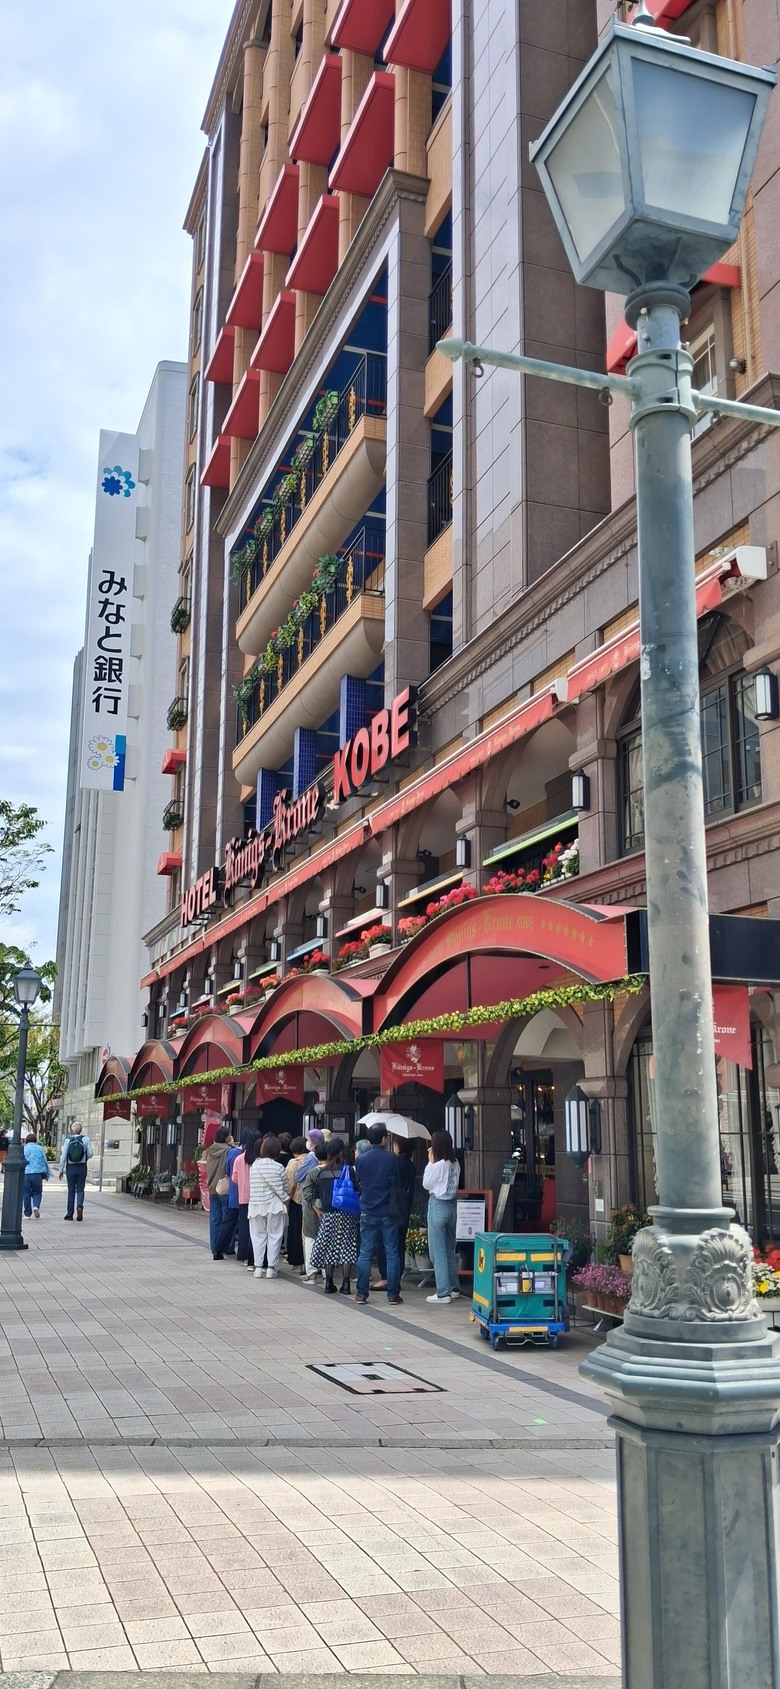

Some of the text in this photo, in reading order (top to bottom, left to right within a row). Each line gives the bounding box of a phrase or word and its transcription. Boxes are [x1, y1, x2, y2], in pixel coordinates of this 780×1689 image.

[93, 570, 127, 714] みなと銀行
[181, 867, 216, 928] HOTEL
[334, 686, 410, 805] KOBE
[516, 915, 535, 930] KOBE
